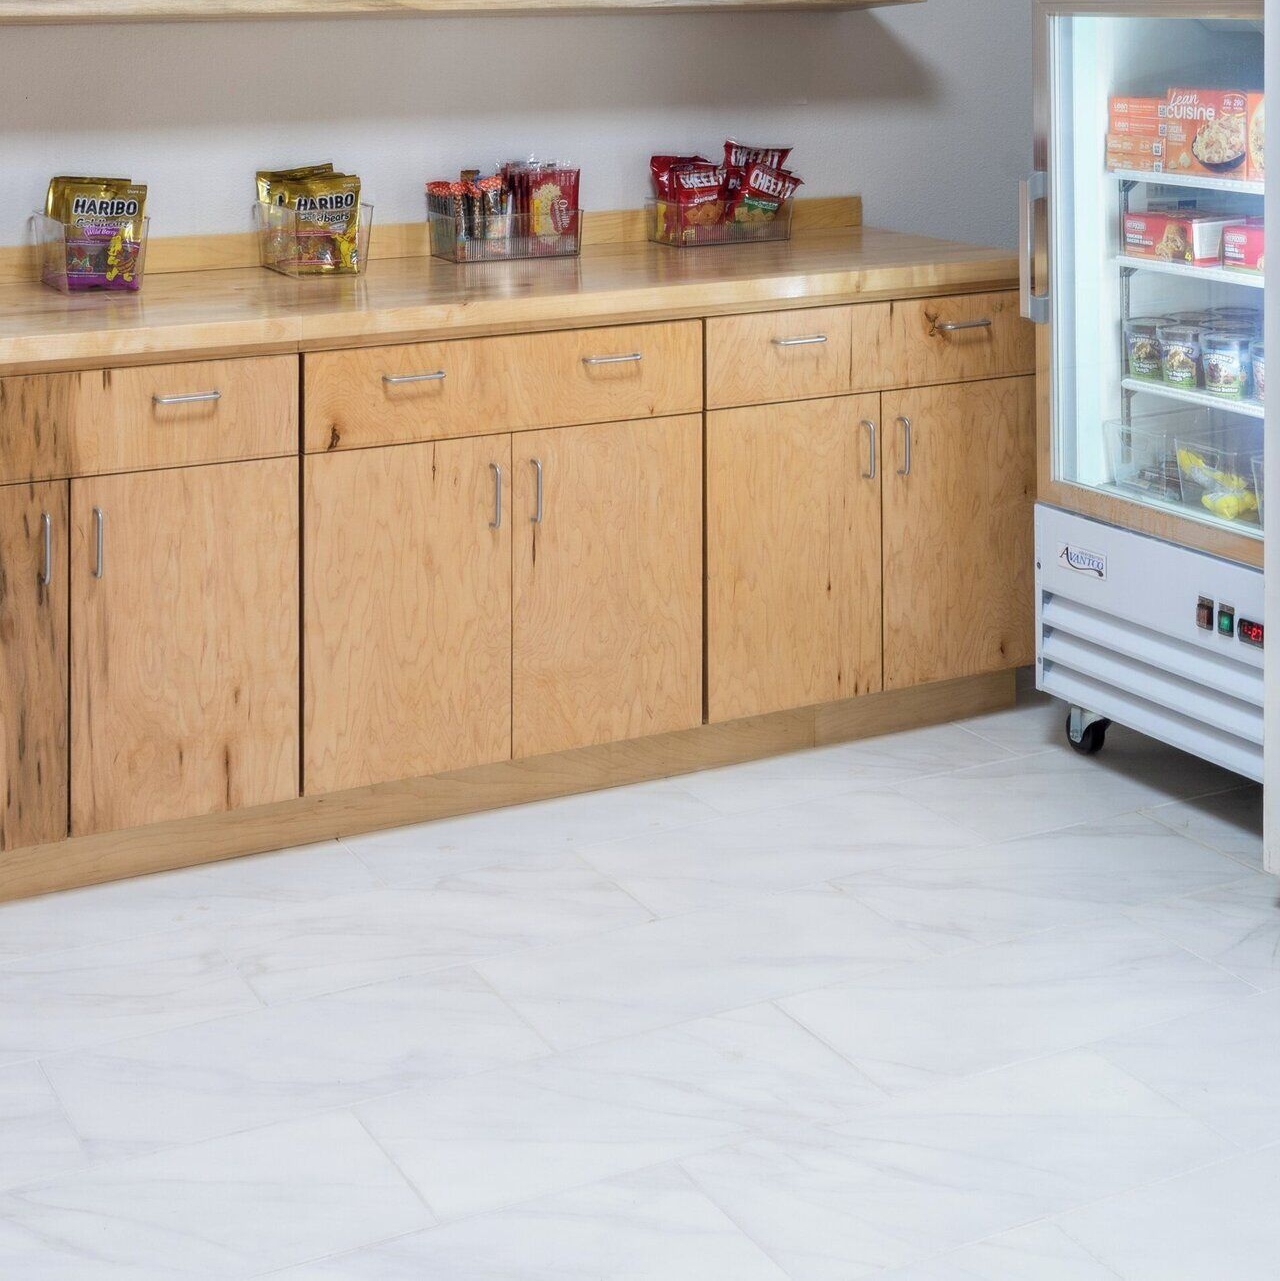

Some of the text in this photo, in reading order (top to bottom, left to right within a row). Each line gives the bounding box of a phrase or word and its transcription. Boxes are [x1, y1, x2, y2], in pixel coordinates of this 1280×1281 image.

[1171, 92, 1200, 106] Lean
[73, 198, 138, 216] HARIBO
[297, 193, 355, 211] HARIBO
[1059, 547, 1104, 570] AVANTCO
